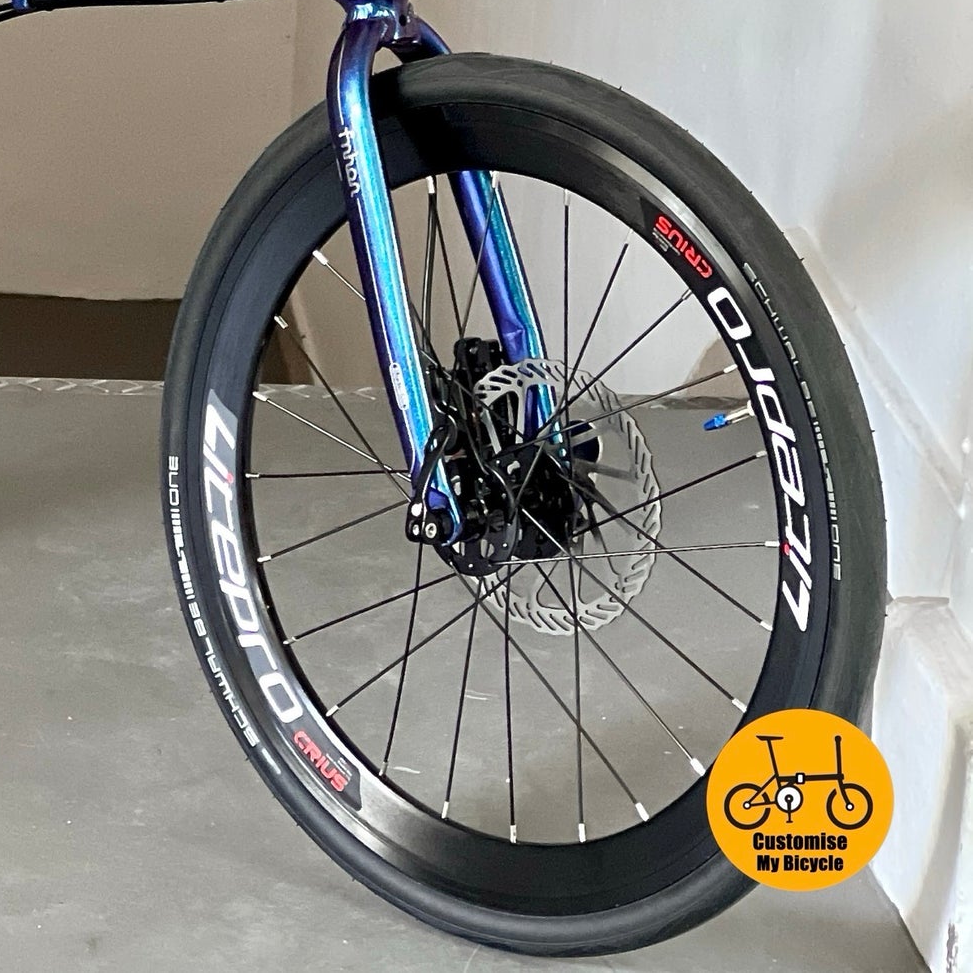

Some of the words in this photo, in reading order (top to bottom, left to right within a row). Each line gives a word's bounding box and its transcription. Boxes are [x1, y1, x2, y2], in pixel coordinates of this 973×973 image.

[656, 216, 713, 278] CRIUS
[188, 601, 260, 747] SCHWALBE
[294, 730, 348, 792] CRIUS
